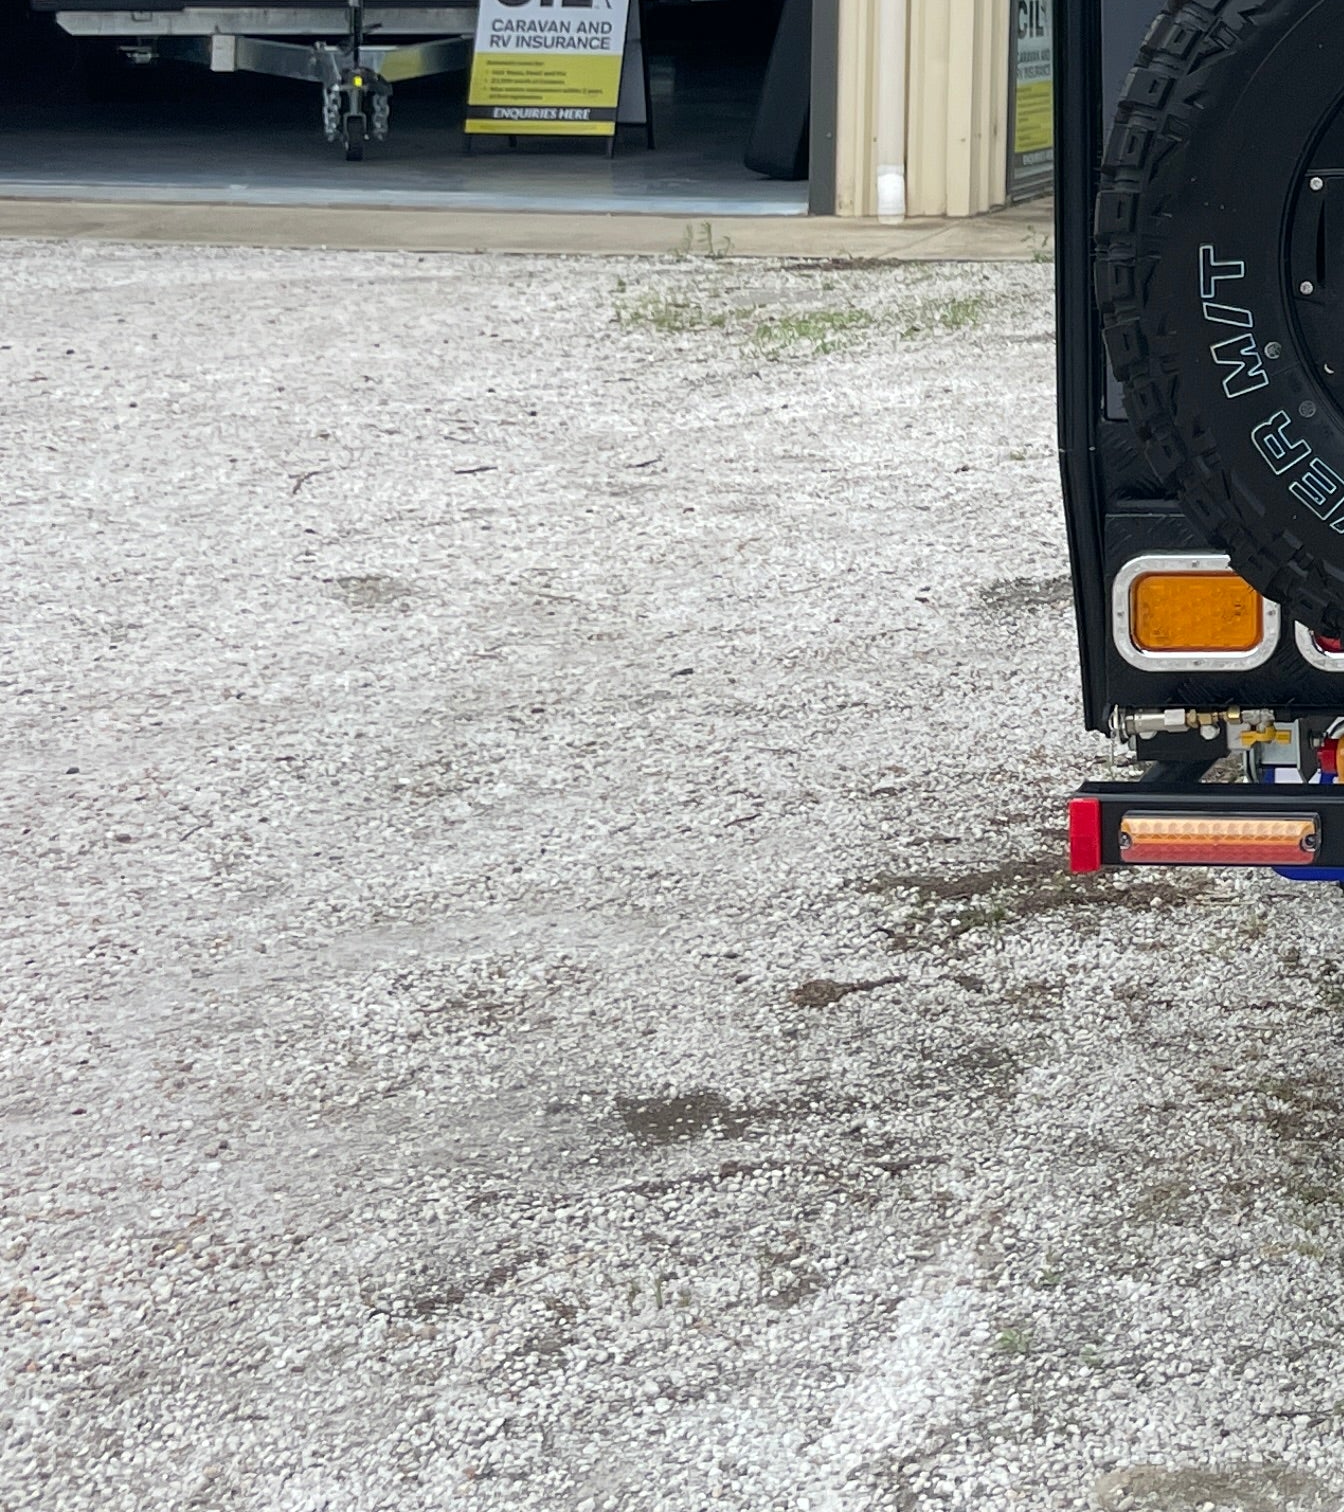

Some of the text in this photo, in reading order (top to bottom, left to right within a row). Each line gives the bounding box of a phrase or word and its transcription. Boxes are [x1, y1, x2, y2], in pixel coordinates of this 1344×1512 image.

[491, 18, 613, 35] CARAVAN AND
[489, 34, 611, 50] RV INSURANCE
[493, 106, 591, 121] ENQUIRIES HERE
[1198, 244, 1270, 399] M/T
